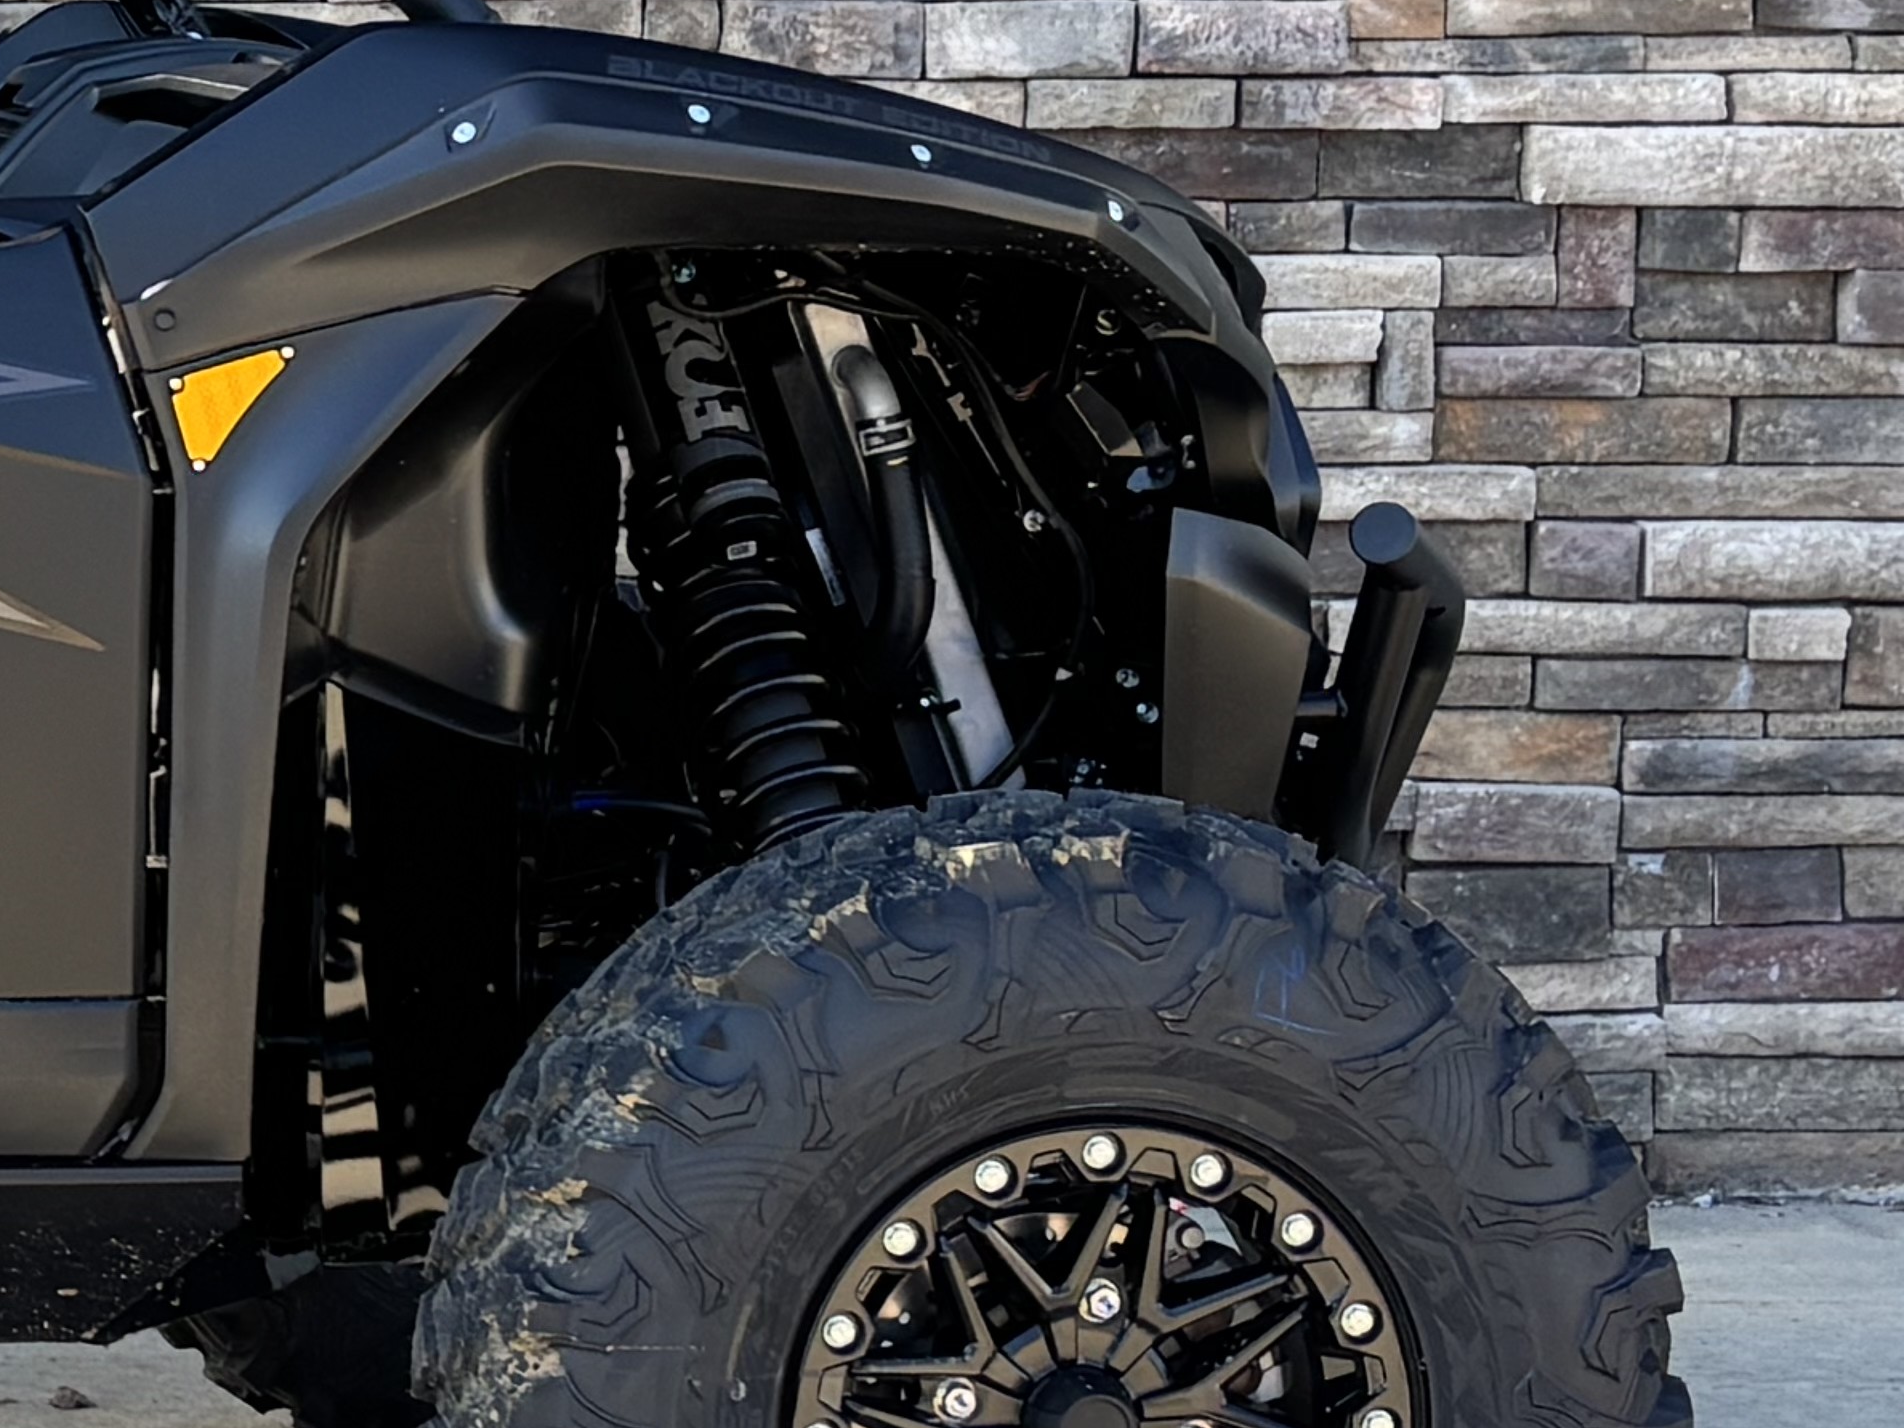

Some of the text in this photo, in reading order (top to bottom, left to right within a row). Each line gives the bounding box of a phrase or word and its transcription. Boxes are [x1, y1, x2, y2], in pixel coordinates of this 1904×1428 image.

[606, 55, 1052, 162] BLACKOUT EDITION
[646, 294, 751, 441] FOX
